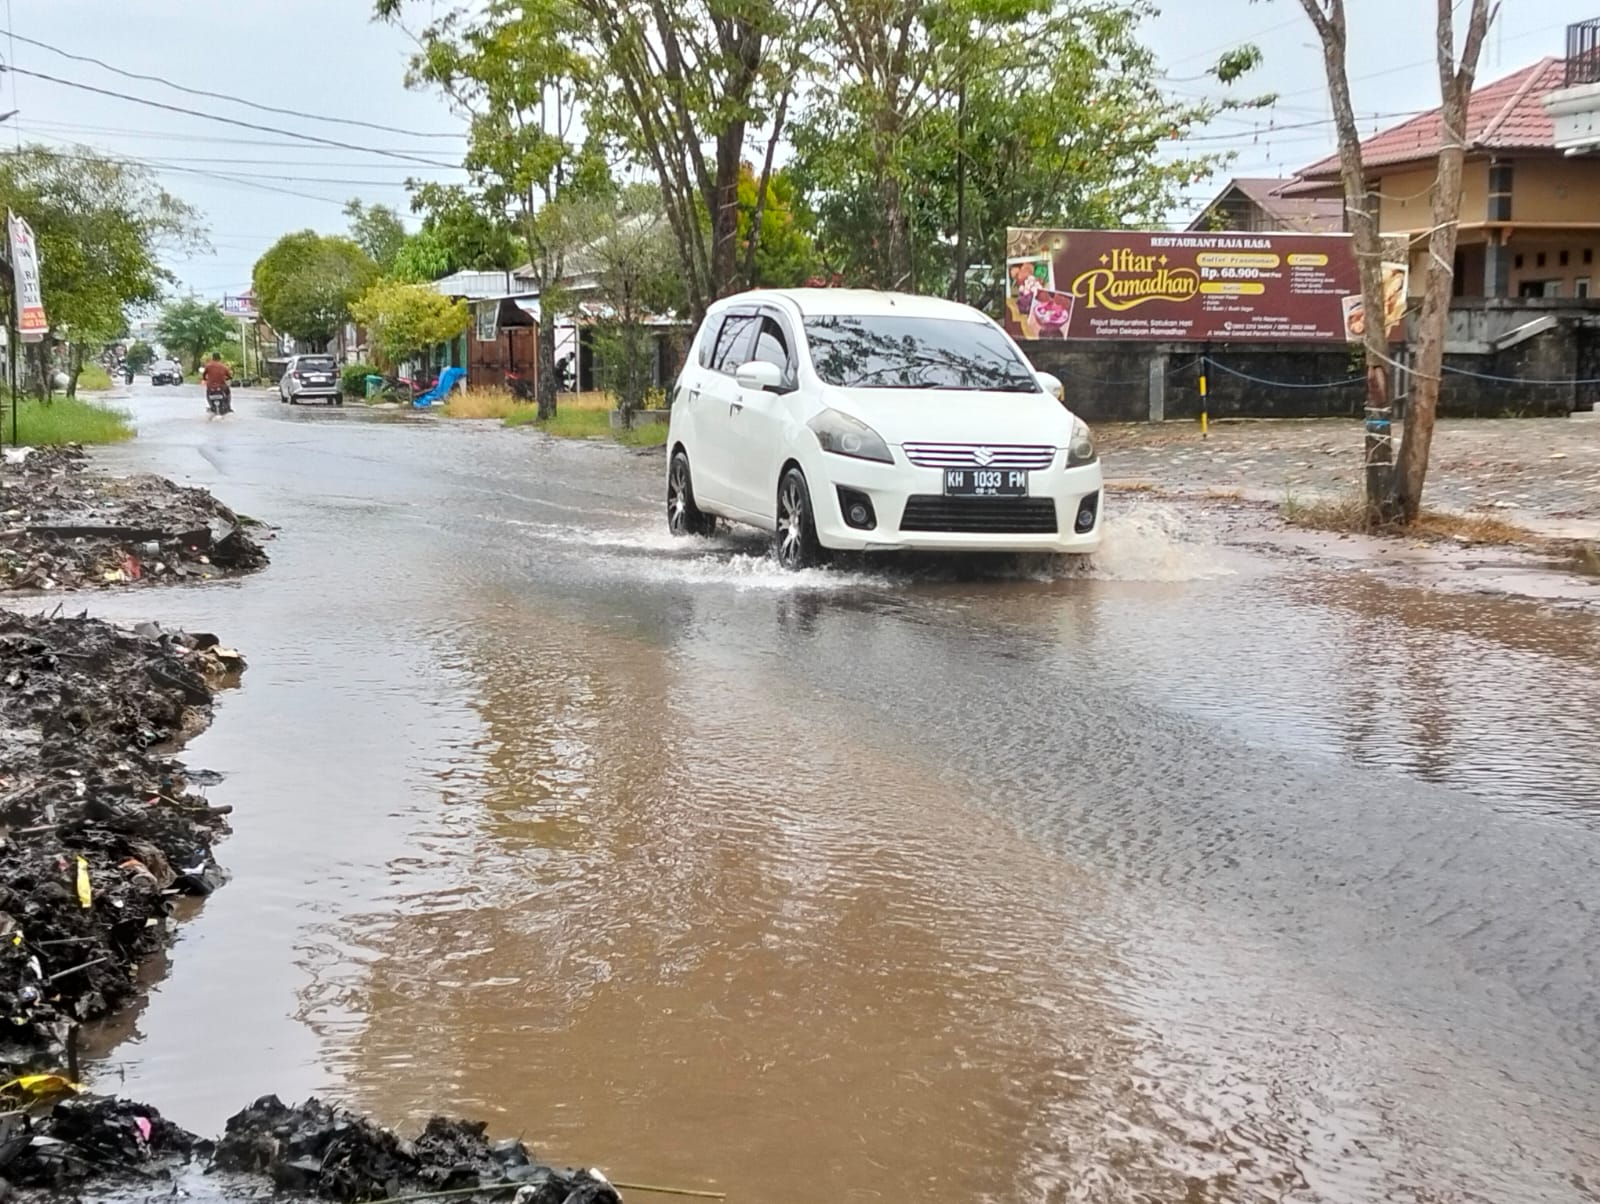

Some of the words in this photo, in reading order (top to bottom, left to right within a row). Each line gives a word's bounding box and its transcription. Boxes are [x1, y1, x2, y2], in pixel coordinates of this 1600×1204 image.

[1150, 237, 1217, 248] RESTAURANT
[1217, 238, 1243, 248] RAJA
[1243, 239, 1272, 249] RASA
[1111, 248, 1157, 273] Iftar
[1201, 267, 1220, 280] Rp.
[1220, 267, 1259, 279] 68.900
[1072, 267, 1200, 311] Ramadhan
[947, 471, 963, 487] KH
[973, 471, 1002, 487] 1033
[1008, 472, 1026, 487] FM
